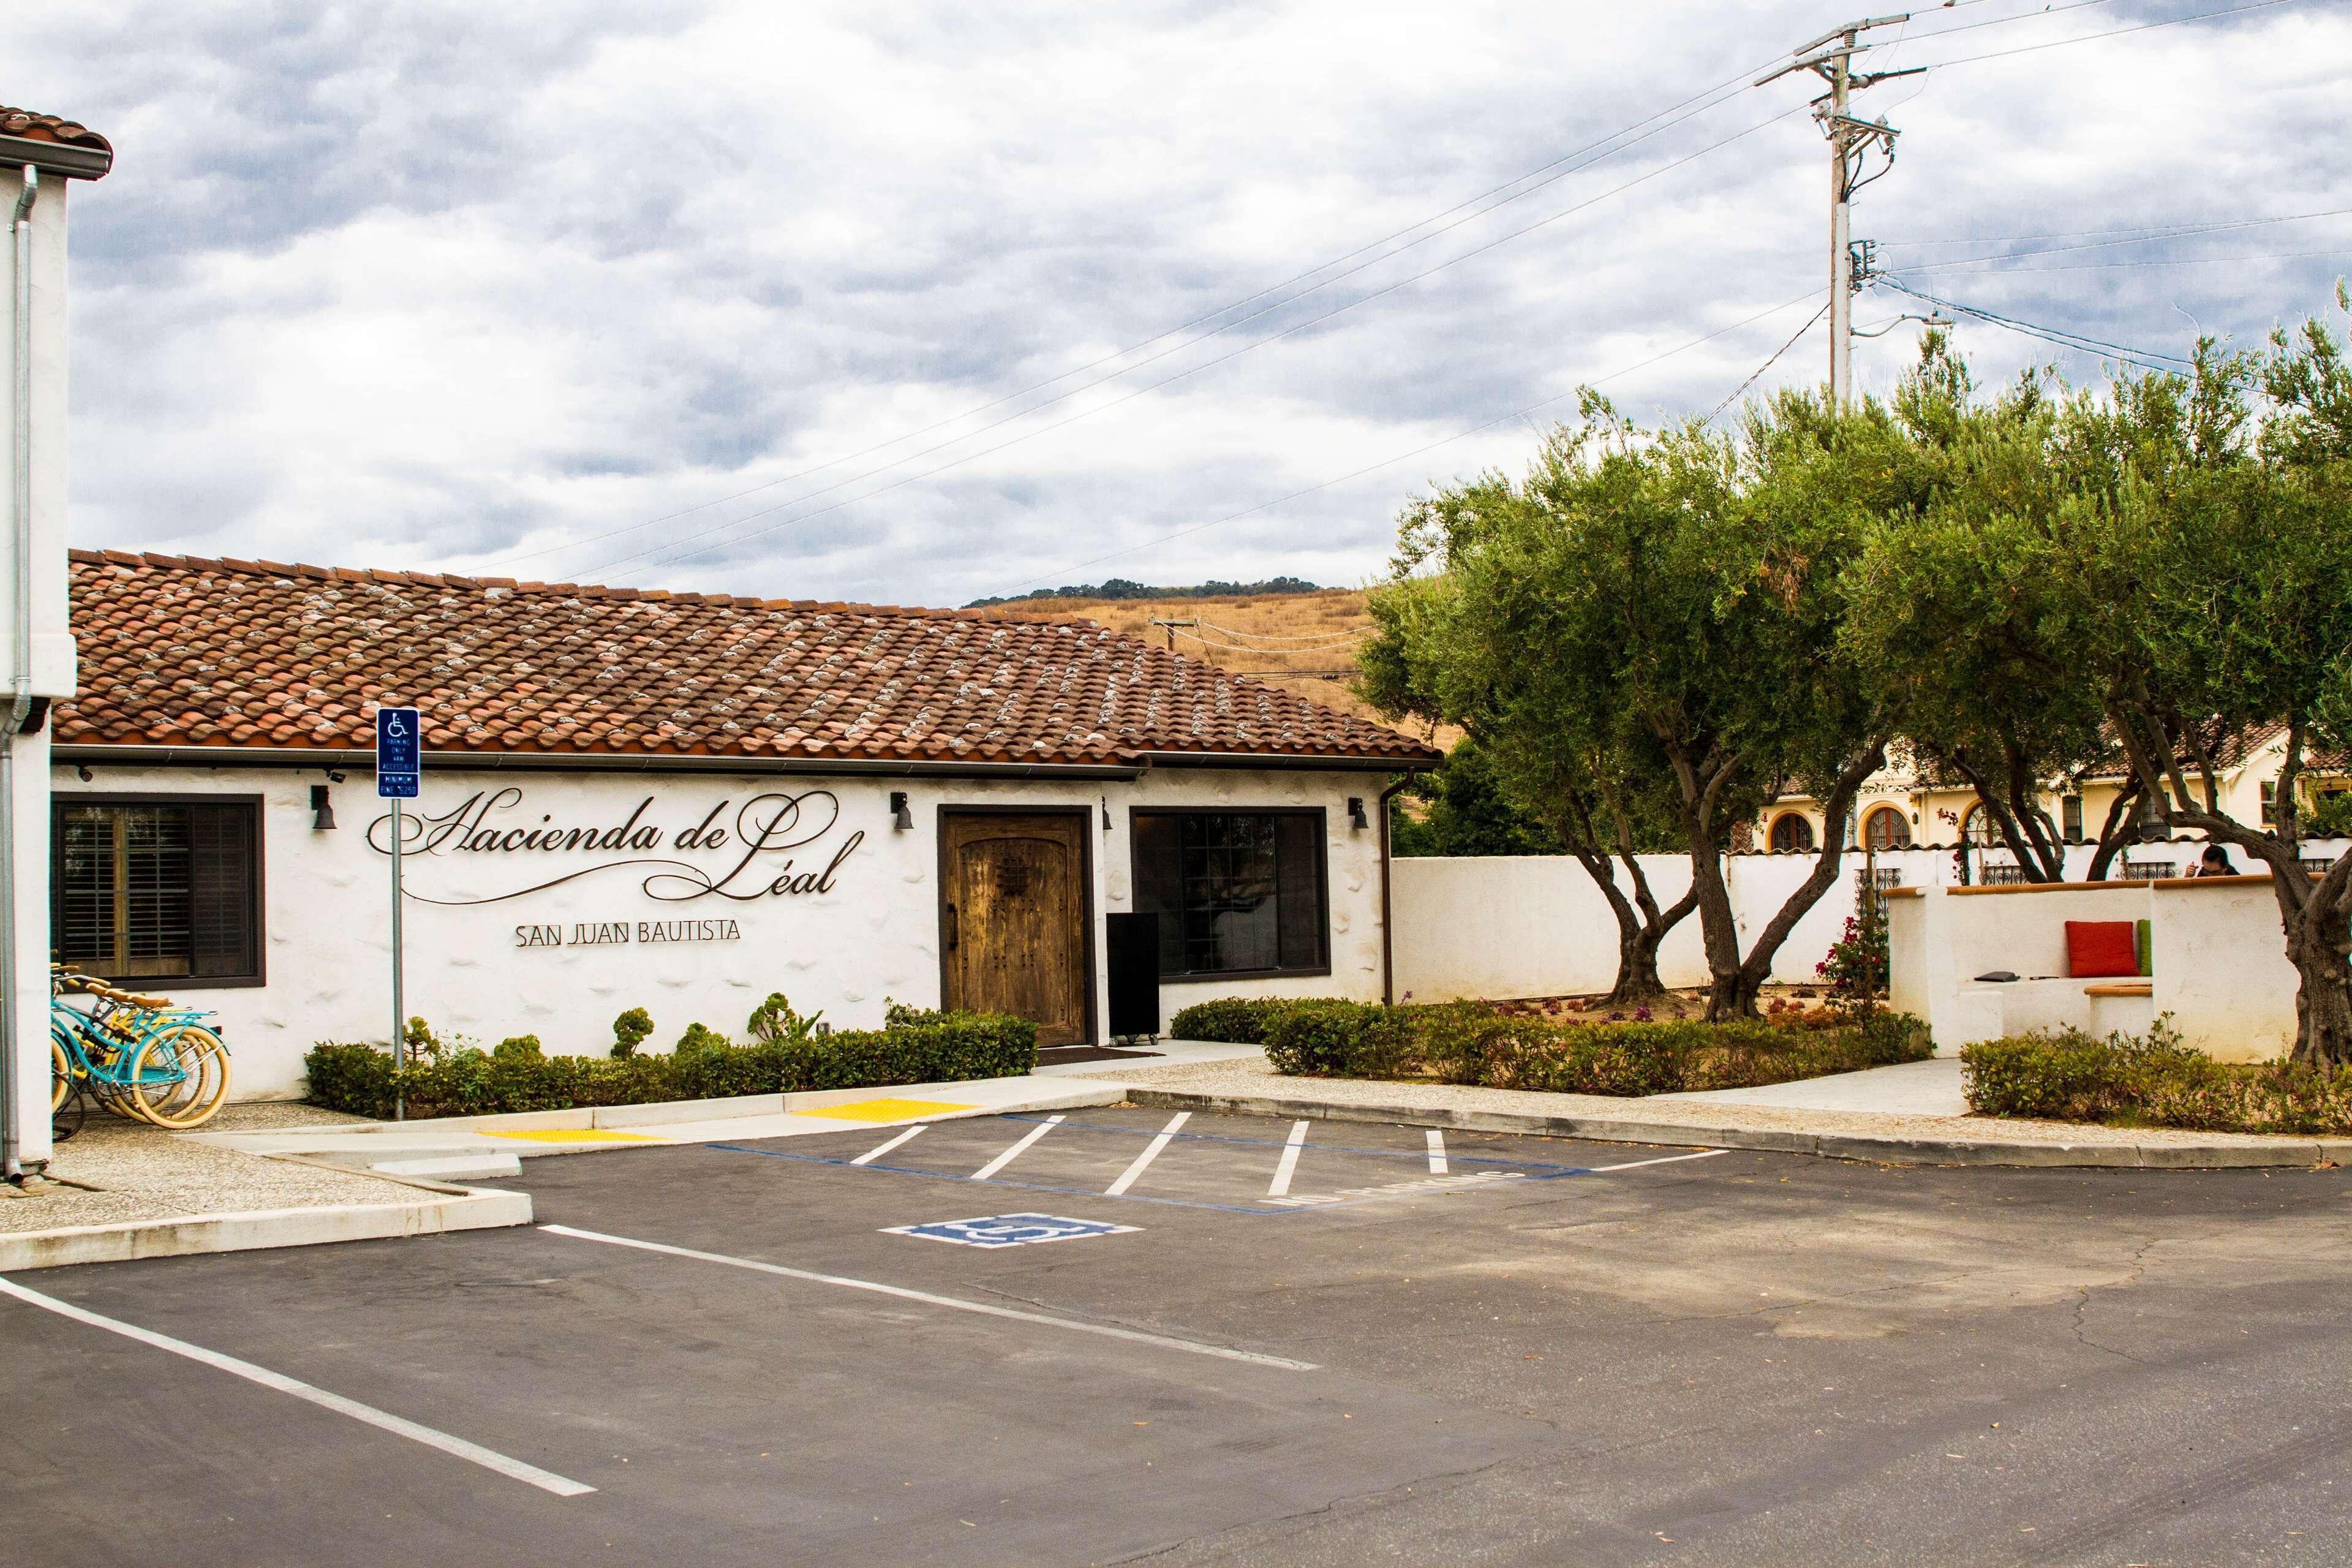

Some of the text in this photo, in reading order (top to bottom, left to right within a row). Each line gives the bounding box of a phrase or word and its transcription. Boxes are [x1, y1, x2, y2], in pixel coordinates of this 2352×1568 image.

[381, 786, 417, 795] FINE $250
[366, 788, 865, 900] Hacienda de Léal
[516, 919, 741, 947] SAN JUAN BAUTISTA
[1256, 1171, 1526, 1206] NO PARKING
